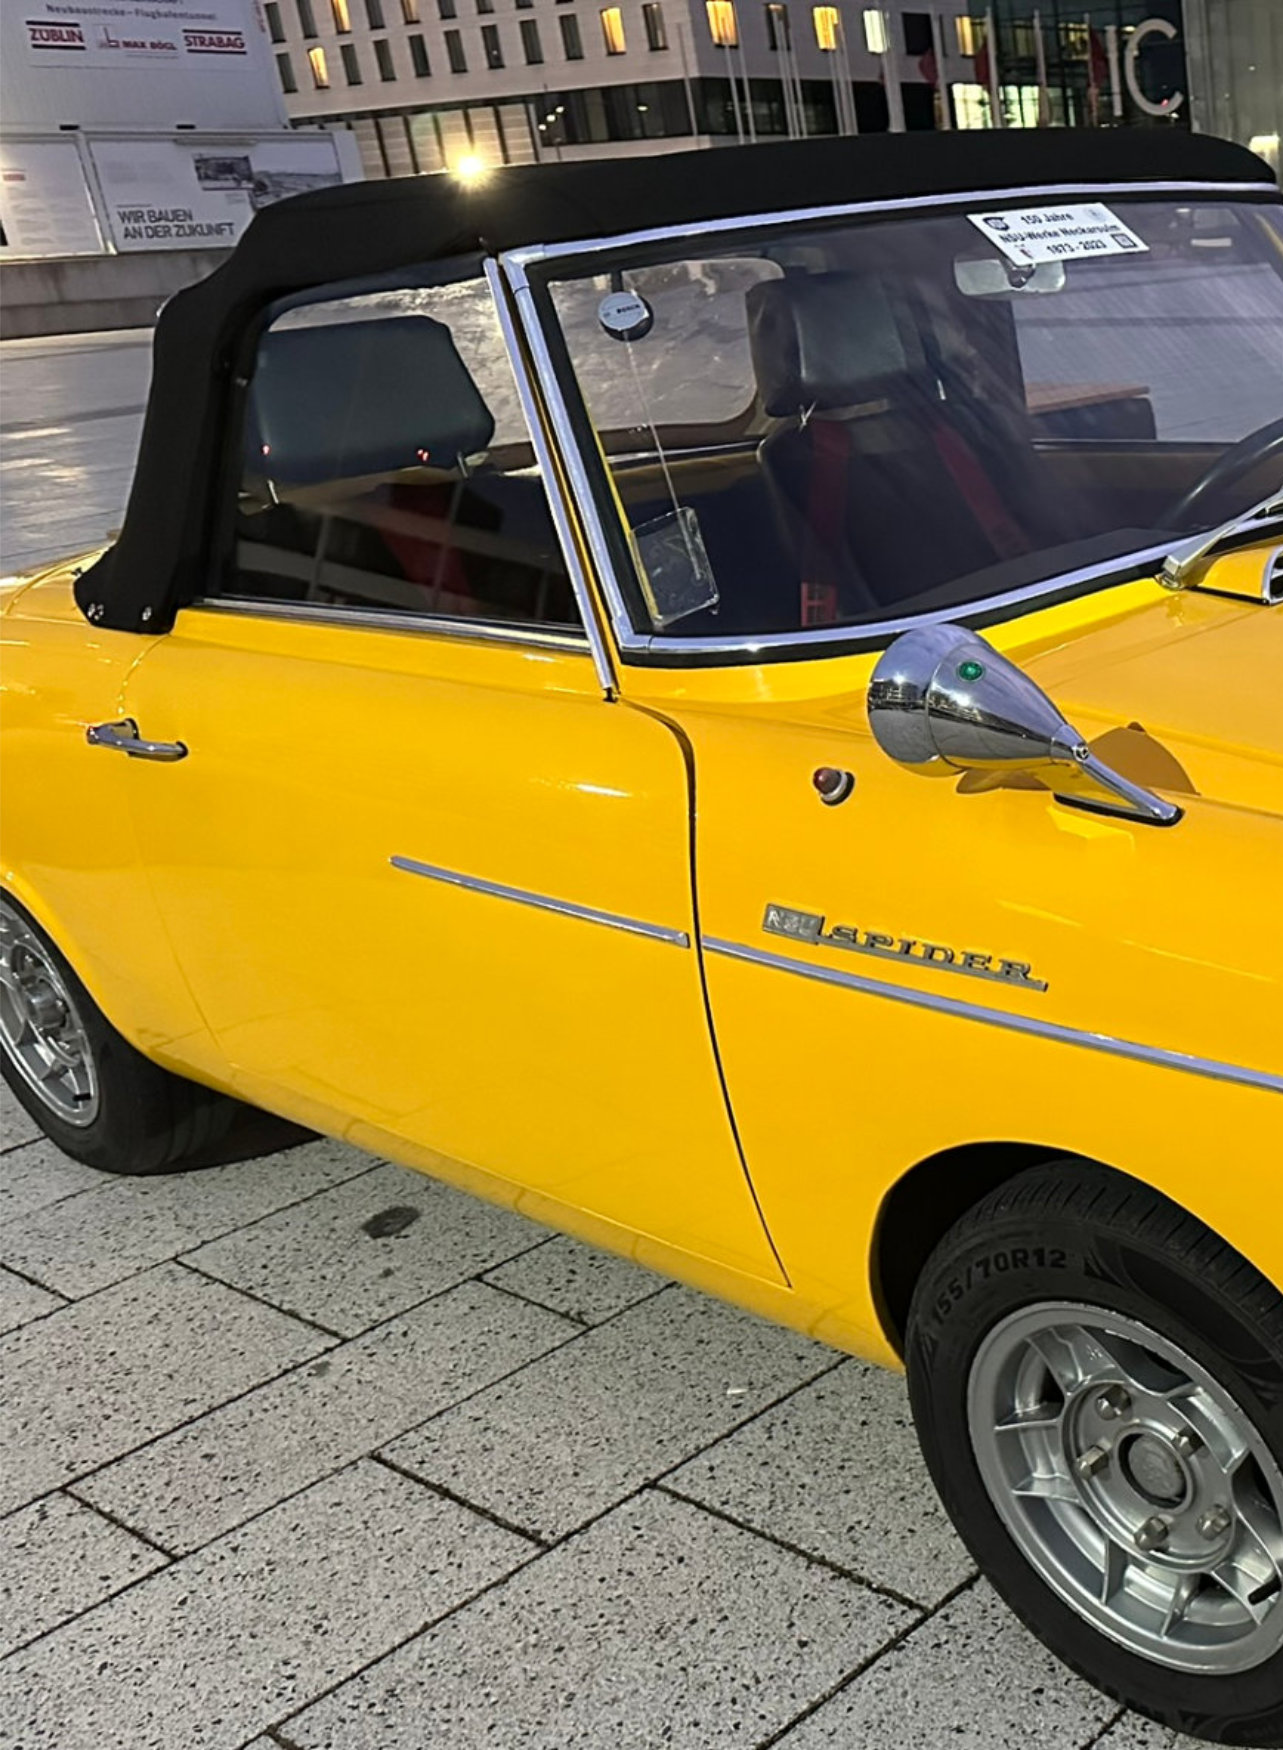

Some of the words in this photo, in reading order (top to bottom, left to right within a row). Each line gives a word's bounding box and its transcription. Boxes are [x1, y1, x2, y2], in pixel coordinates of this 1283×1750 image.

[121, 40, 146, 49] MAX
[184, 35, 245, 50] STRABAG
[117, 209, 146, 224] WIR
[149, 207, 194, 223] BAUEN
[1021, 215, 1043, 225] 150
[1043, 211, 1074, 223] Jahre
[123, 225, 143, 240] AN
[144, 224, 171, 239] DER
[174, 221, 235, 237] ZUKUNFT
[999, 229, 1060, 244] NSU-Werke
[1059, 223, 1120, 237] Neckarsulm
[829, 924, 1034, 982] SPIDER
[932, 1246, 1068, 1325] 155/70R12
